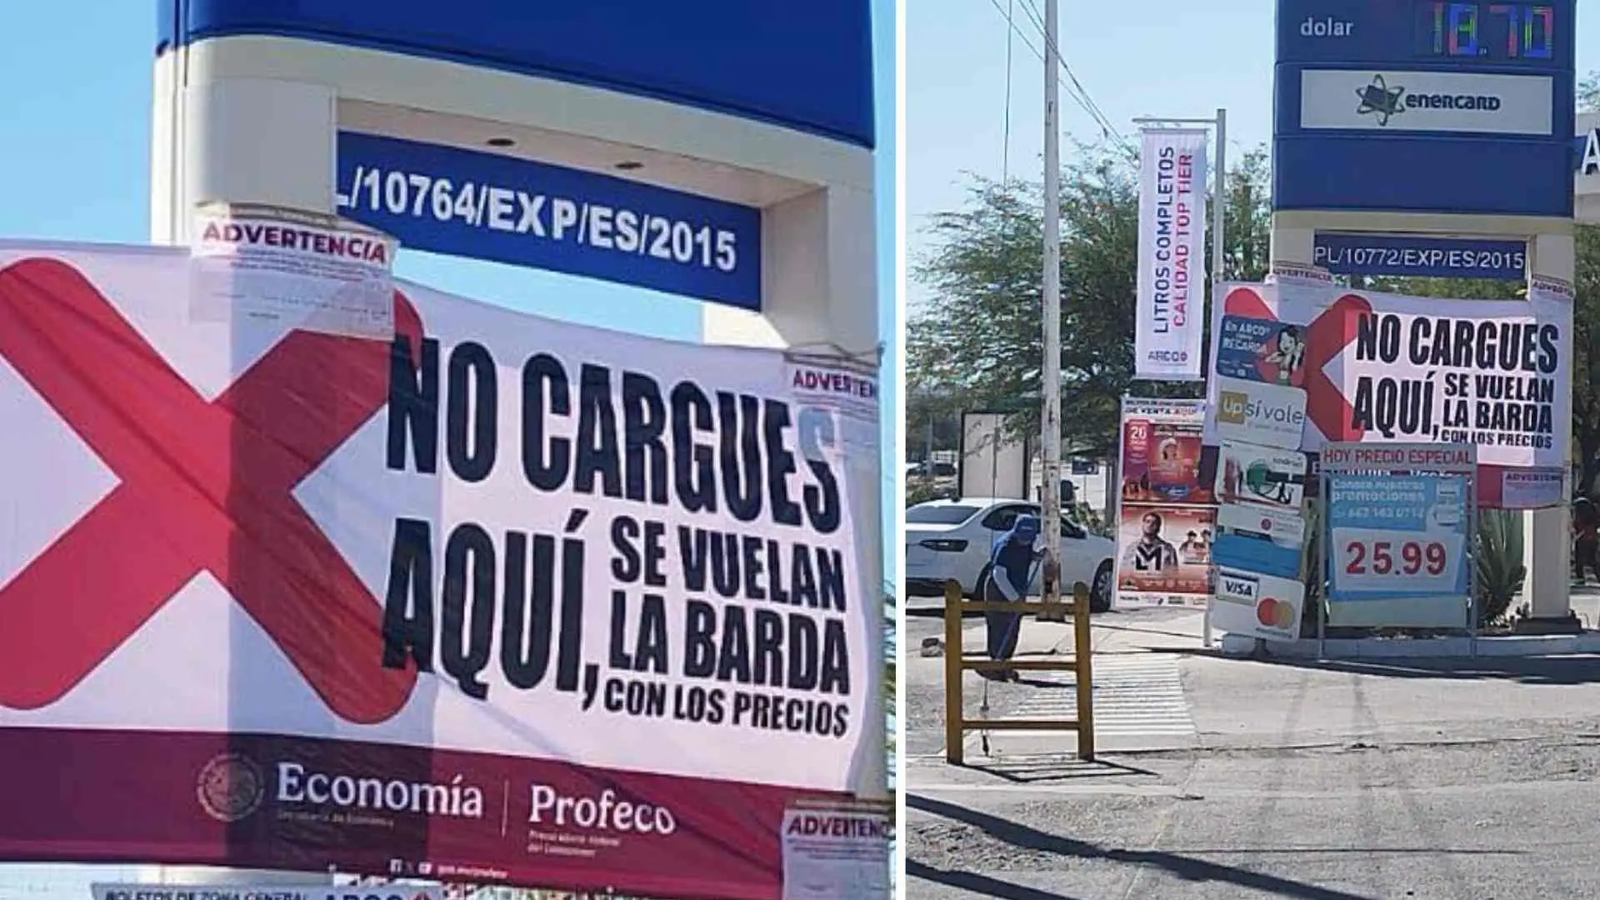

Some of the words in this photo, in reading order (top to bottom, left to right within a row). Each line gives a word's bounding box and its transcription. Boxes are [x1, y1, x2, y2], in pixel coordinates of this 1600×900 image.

[1300, 18, 1353, 37] dolar
[1178, 154, 1194, 194] TIER
[1156, 147, 1175, 262] COMPLETOS
[1176, 203, 1191, 236] TOP
[203, 221, 388, 264] ADVERTENCIA
[1154, 266, 1171, 334] LITROS
[1173, 244, 1190, 327] CALIDAD
[1356, 313, 1401, 364] NO
[1409, 317, 1559, 374] CARGUES
[1351, 370, 1438, 441] AQUÍ,
[1444, 373, 1469, 397] SE
[1475, 375, 1554, 403] VUELAN
[1443, 399, 1469, 428] LA
[1475, 401, 1553, 433] BARDA
[387, 335, 497, 482] NO
[521, 353, 842, 535] CARGUES
[1324, 449, 1350, 462] HOY
[1355, 450, 1404, 464] PRECIO
[1408, 451, 1473, 465] ESPECIAL
[1441, 429, 1468, 444] CON
[1471, 431, 1494, 445] LOS
[1498, 434, 1553, 449] PRECIOS
[1346, 541, 1447, 576] 25.99
[381, 508, 599, 712] AQUÍ,
[610, 516, 667, 587] SE
[677, 525, 847, 613] VUELAN
[1225, 579, 1253, 597] VISA
[609, 590, 669, 676] LA
[684, 600, 851, 695] BARDA
[604, 678, 668, 719] CON
[673, 684, 725, 725] LOS
[731, 692, 850, 739] PRECIOS
[277, 761, 484, 818] Economía
[528, 784, 677, 835] Profeco
